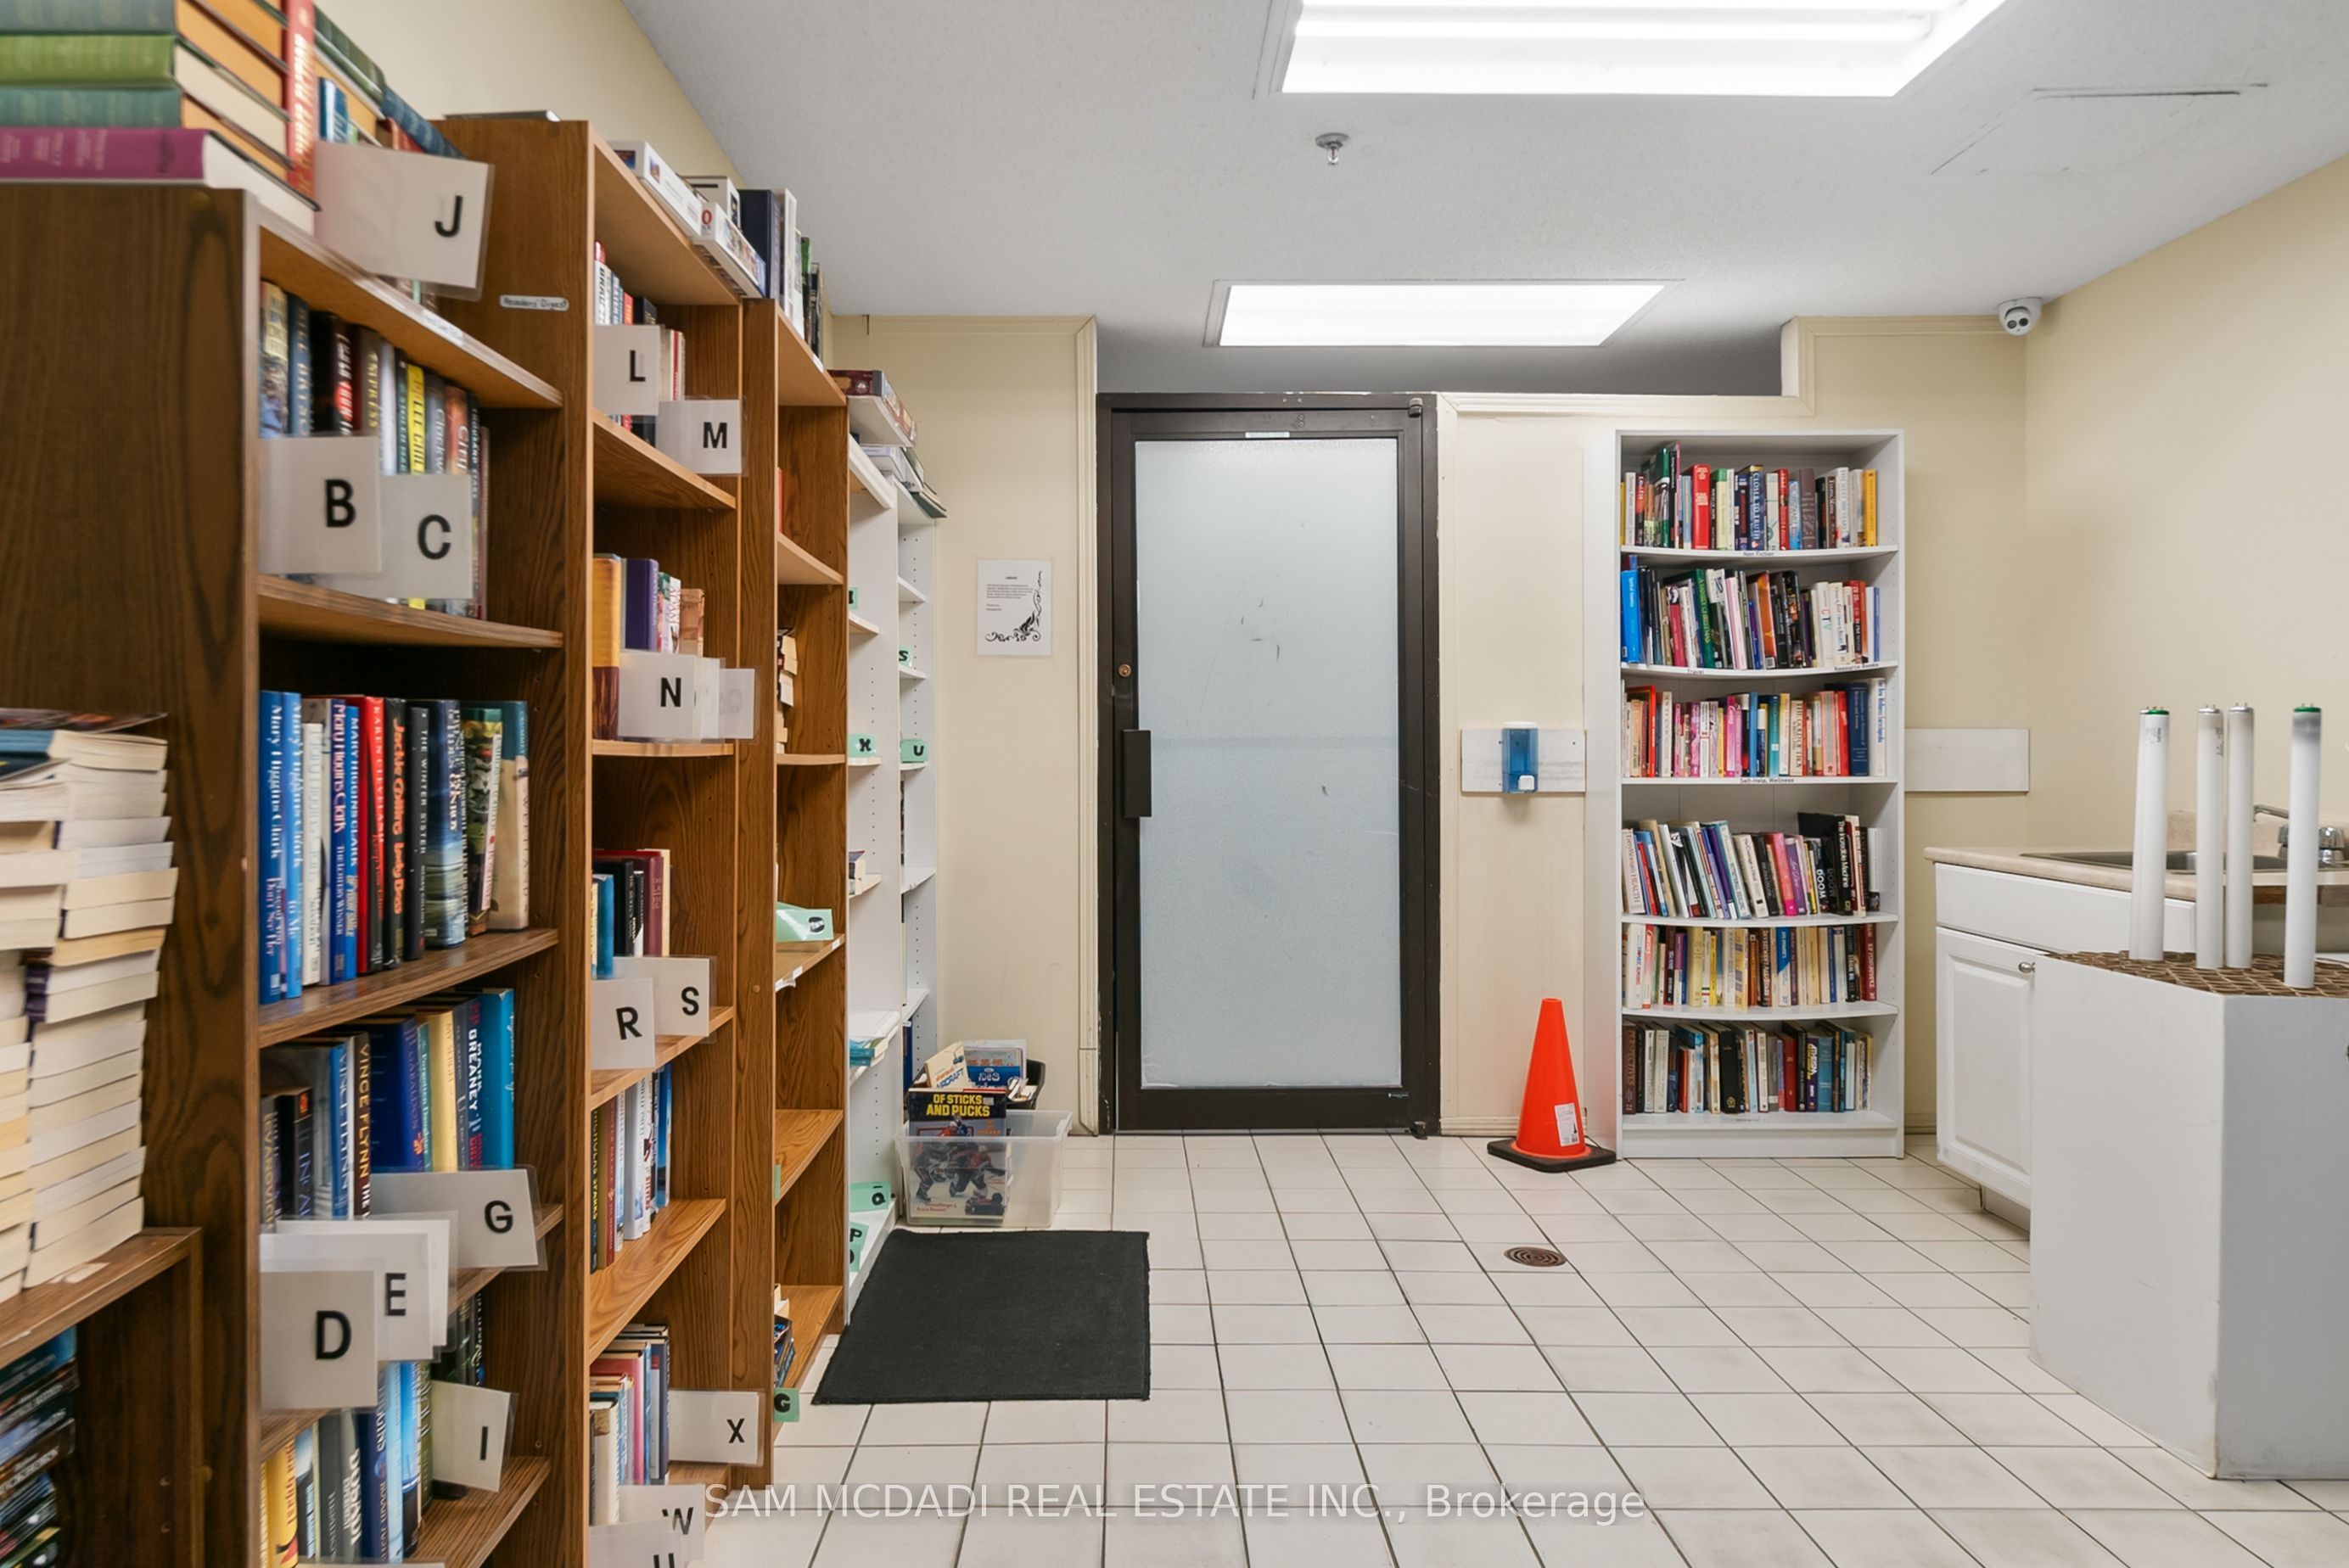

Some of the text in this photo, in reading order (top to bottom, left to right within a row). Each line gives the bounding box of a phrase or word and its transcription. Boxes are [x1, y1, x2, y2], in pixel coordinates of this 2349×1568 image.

[434, 194, 463, 238] J
[629, 350, 646, 382] L
[298, 362, 309, 436] BRYSO
[413, 434, 423, 473] CHIL
[434, 408, 446, 473] Clockw
[456, 425, 469, 470] City
[703, 422, 727, 449] M
[325, 479, 356, 528] B
[418, 514, 451, 560] C
[1820, 608, 1831, 630] CTV
[898, 650, 908, 662] S
[659, 676, 681, 708] N
[334, 704, 347, 741] Mary
[913, 745, 924, 757] U
[350, 718, 360, 866] MARY HIGGINS CLARK
[374, 706, 386, 843] KAREN CLEVELAND
[393, 719, 406, 836] Jackie Collins
[334, 792, 347, 833] Clark
[394, 843, 406, 878] Lady
[1839, 832, 1847, 861] Incredible
[1816, 869, 1826, 899] DOOM
[681, 986, 699, 1016] S
[615, 1005, 642, 1041] R
[360, 1044, 370, 1107] VINCE
[468, 1028, 478, 1111] GREANEY
[926, 1105, 990, 1117] AND PUCKS
[933, 1094, 982, 1105] OF STICKS
[359, 1113, 370, 1179] FLYNN
[484, 1200, 514, 1234] G
[849, 1228, 862, 1242] P
[384, 1272, 407, 1316] E
[315, 1310, 352, 1360] D
[775, 1392, 791, 1413] G
[479, 1425, 490, 1461] I
[726, 1418, 745, 1443] X
[350, 1448, 362, 1546] DOSADI
